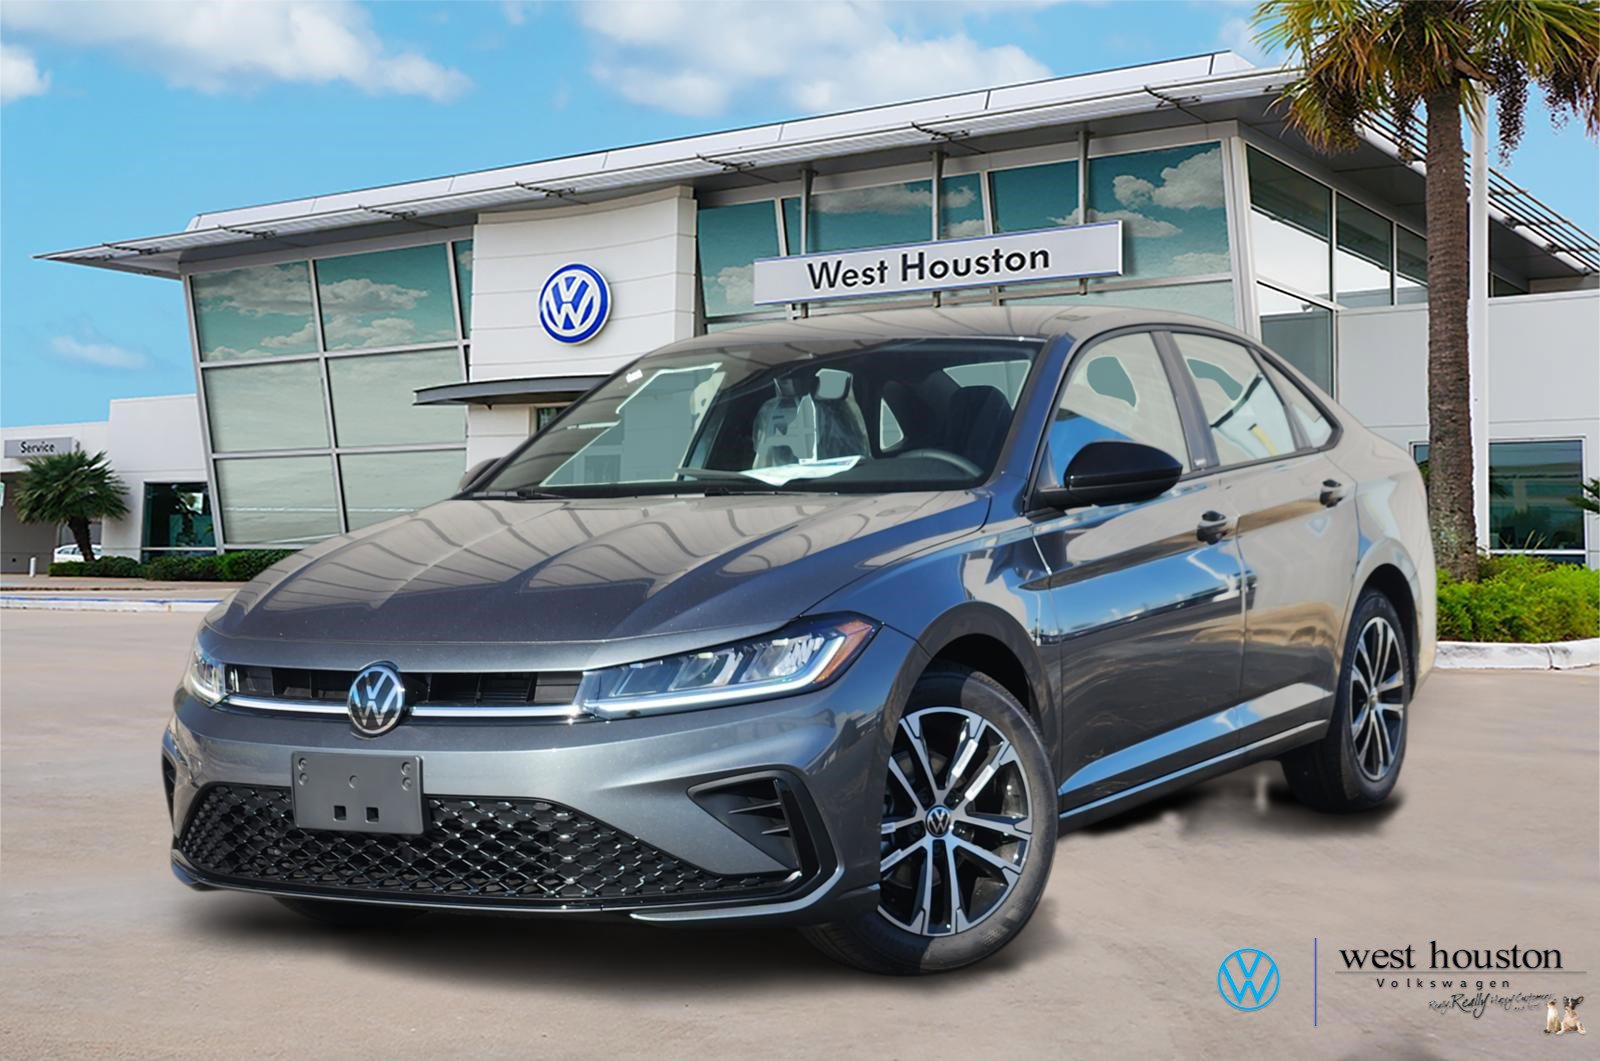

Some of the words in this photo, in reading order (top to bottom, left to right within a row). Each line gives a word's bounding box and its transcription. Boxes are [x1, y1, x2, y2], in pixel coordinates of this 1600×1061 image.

[807, 260, 888, 290] West
[900, 248, 1050, 282] Houston
[20, 441, 55, 454] Service
